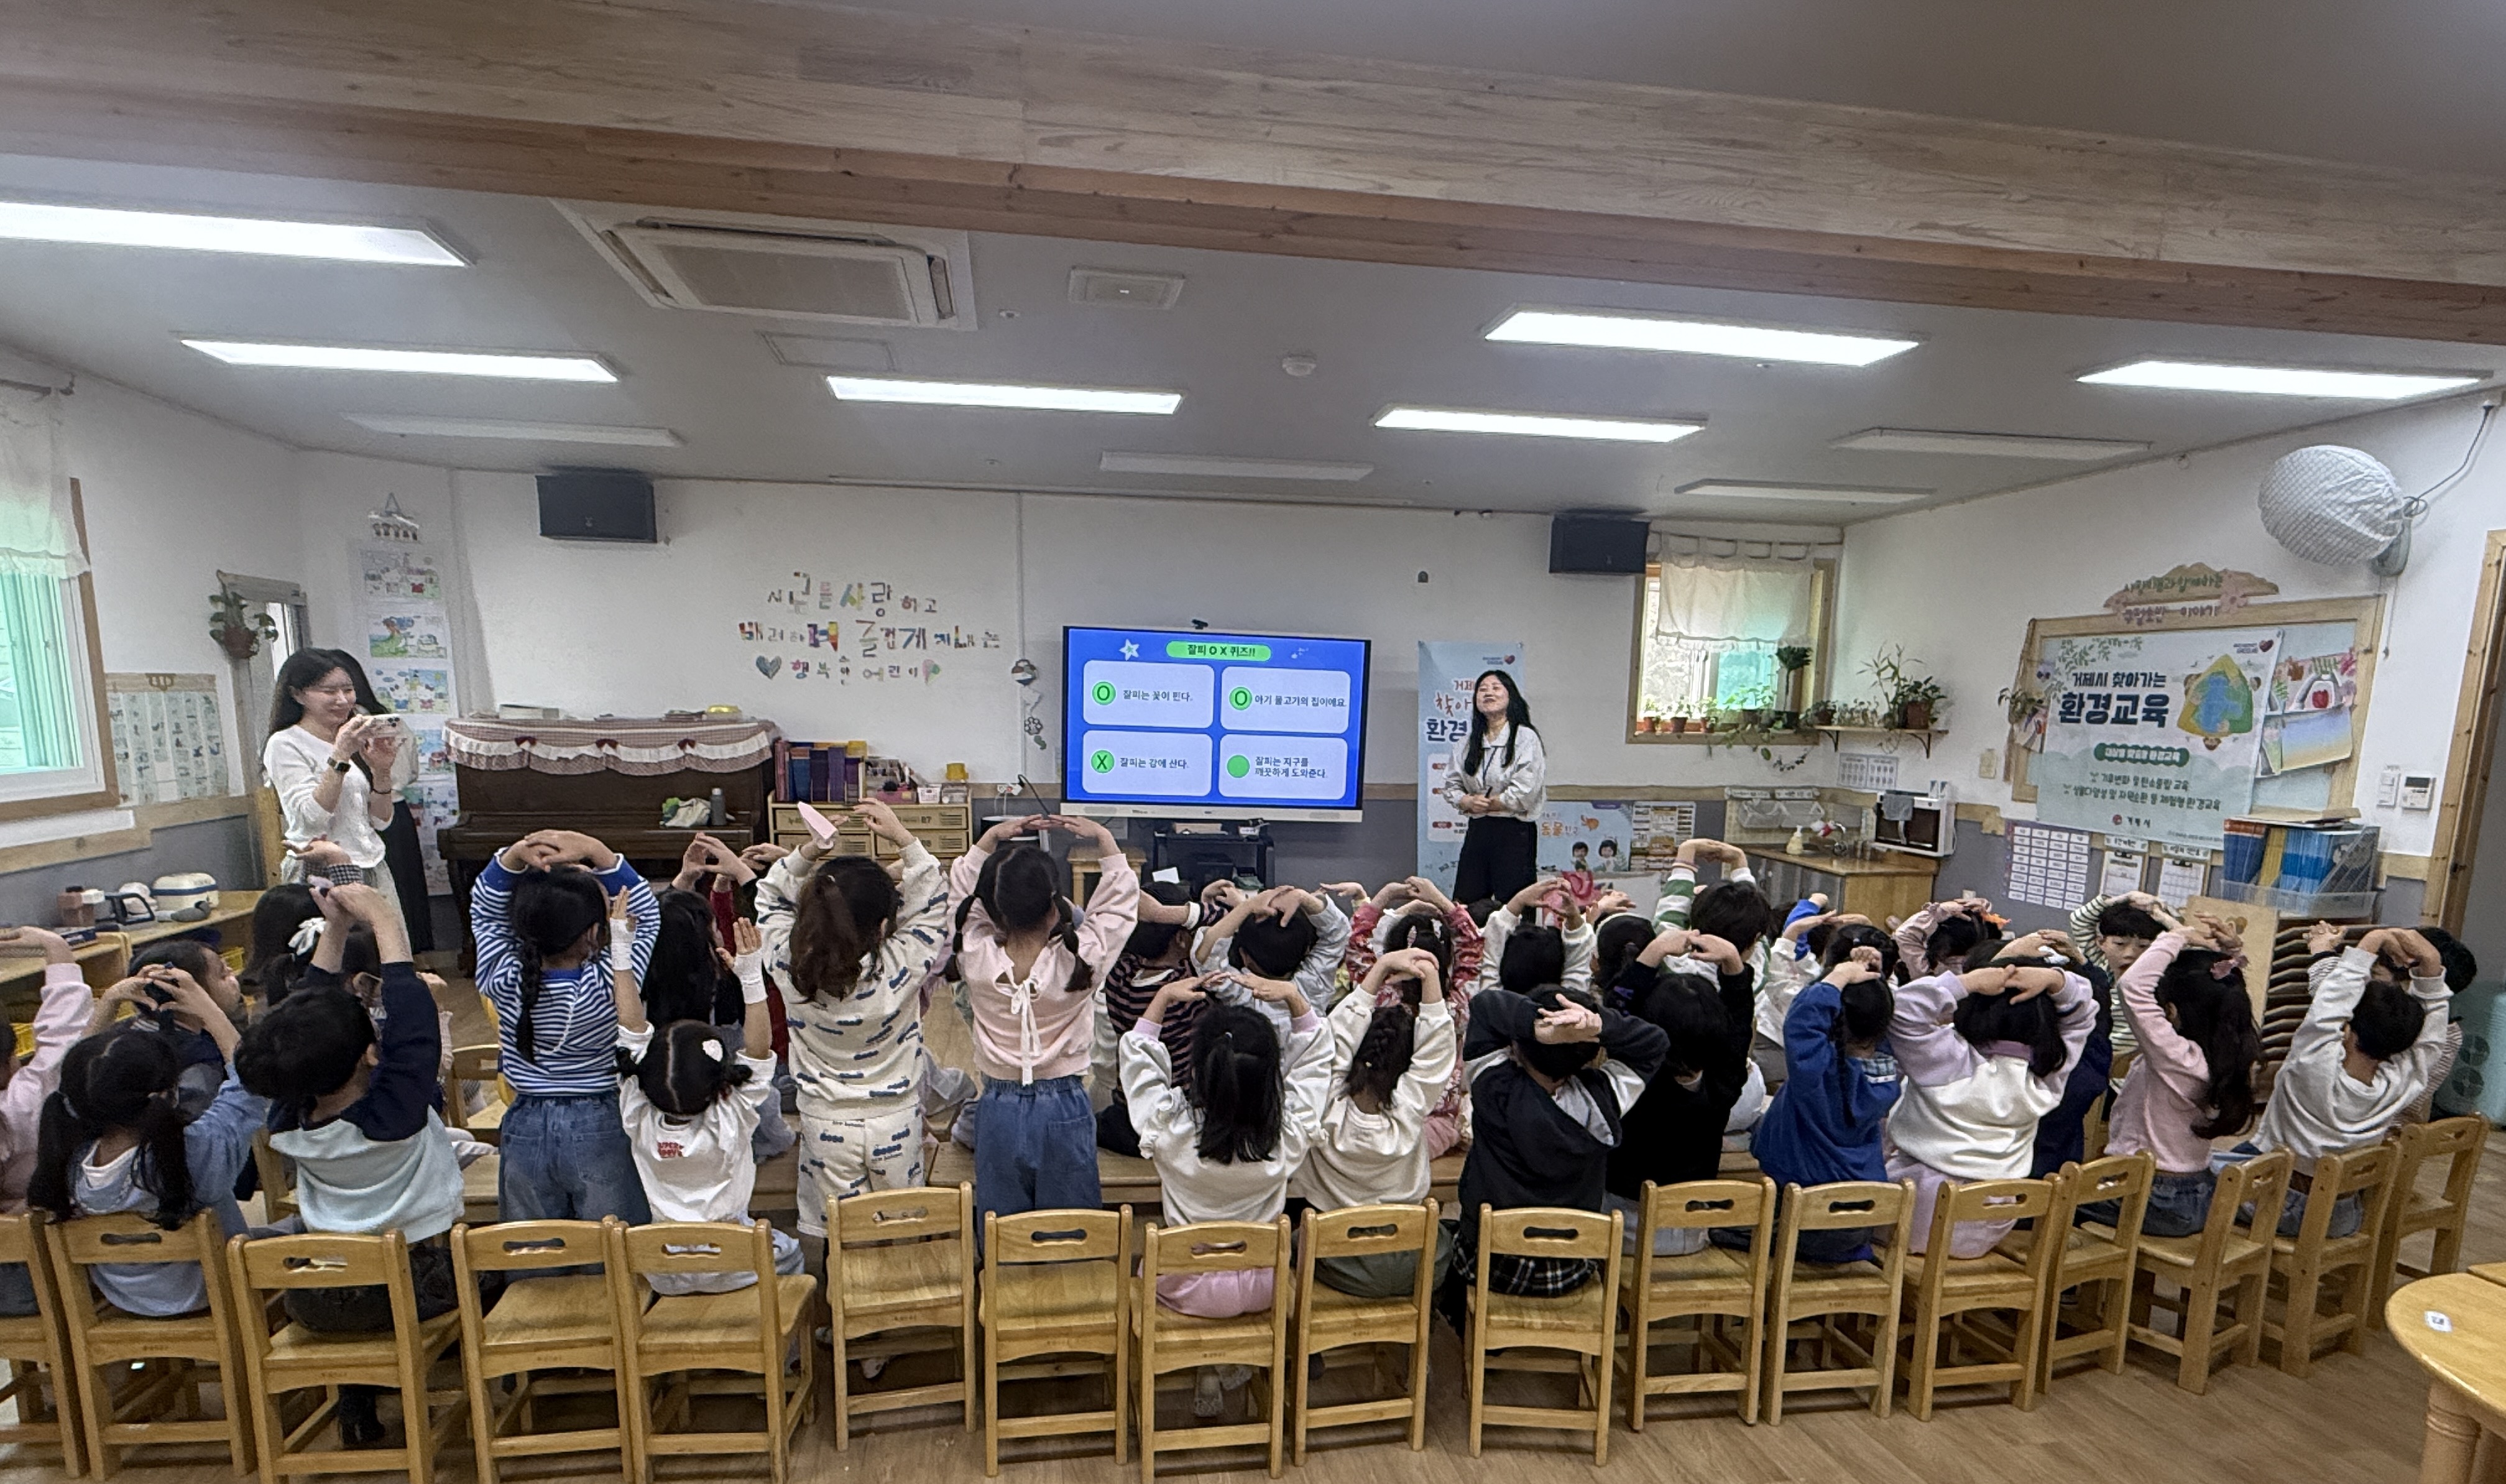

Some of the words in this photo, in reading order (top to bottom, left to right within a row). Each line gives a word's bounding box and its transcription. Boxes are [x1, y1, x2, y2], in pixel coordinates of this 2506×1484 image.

[840, 583, 937, 617] 사랑하고
[1187, 644, 1206, 657] 잘피
[1220, 647, 1227, 655] X
[863, 665, 918, 682] 어린이
[2072, 672, 2109, 687] 거제시
[2112, 671, 2167, 688] 찾아가는
[1453, 680, 1475, 691] 거제
[1123, 689, 1149, 701] 잘피는
[1152, 691, 1170, 701] 꽃이
[1255, 694, 1272, 705] 아기
[1435, 691, 1472, 717] 찾아
[2058, 691, 2170, 729] 환경교육
[1426, 718, 1468, 742] 환경
[1097, 754, 1108, 770] X
[1120, 757, 1146, 768] 잘피는
[1255, 756, 1281, 767] 잘피는
[1283, 757, 1309, 767] 지구를
[1255, 767, 1289, 777] 깨끗하게
